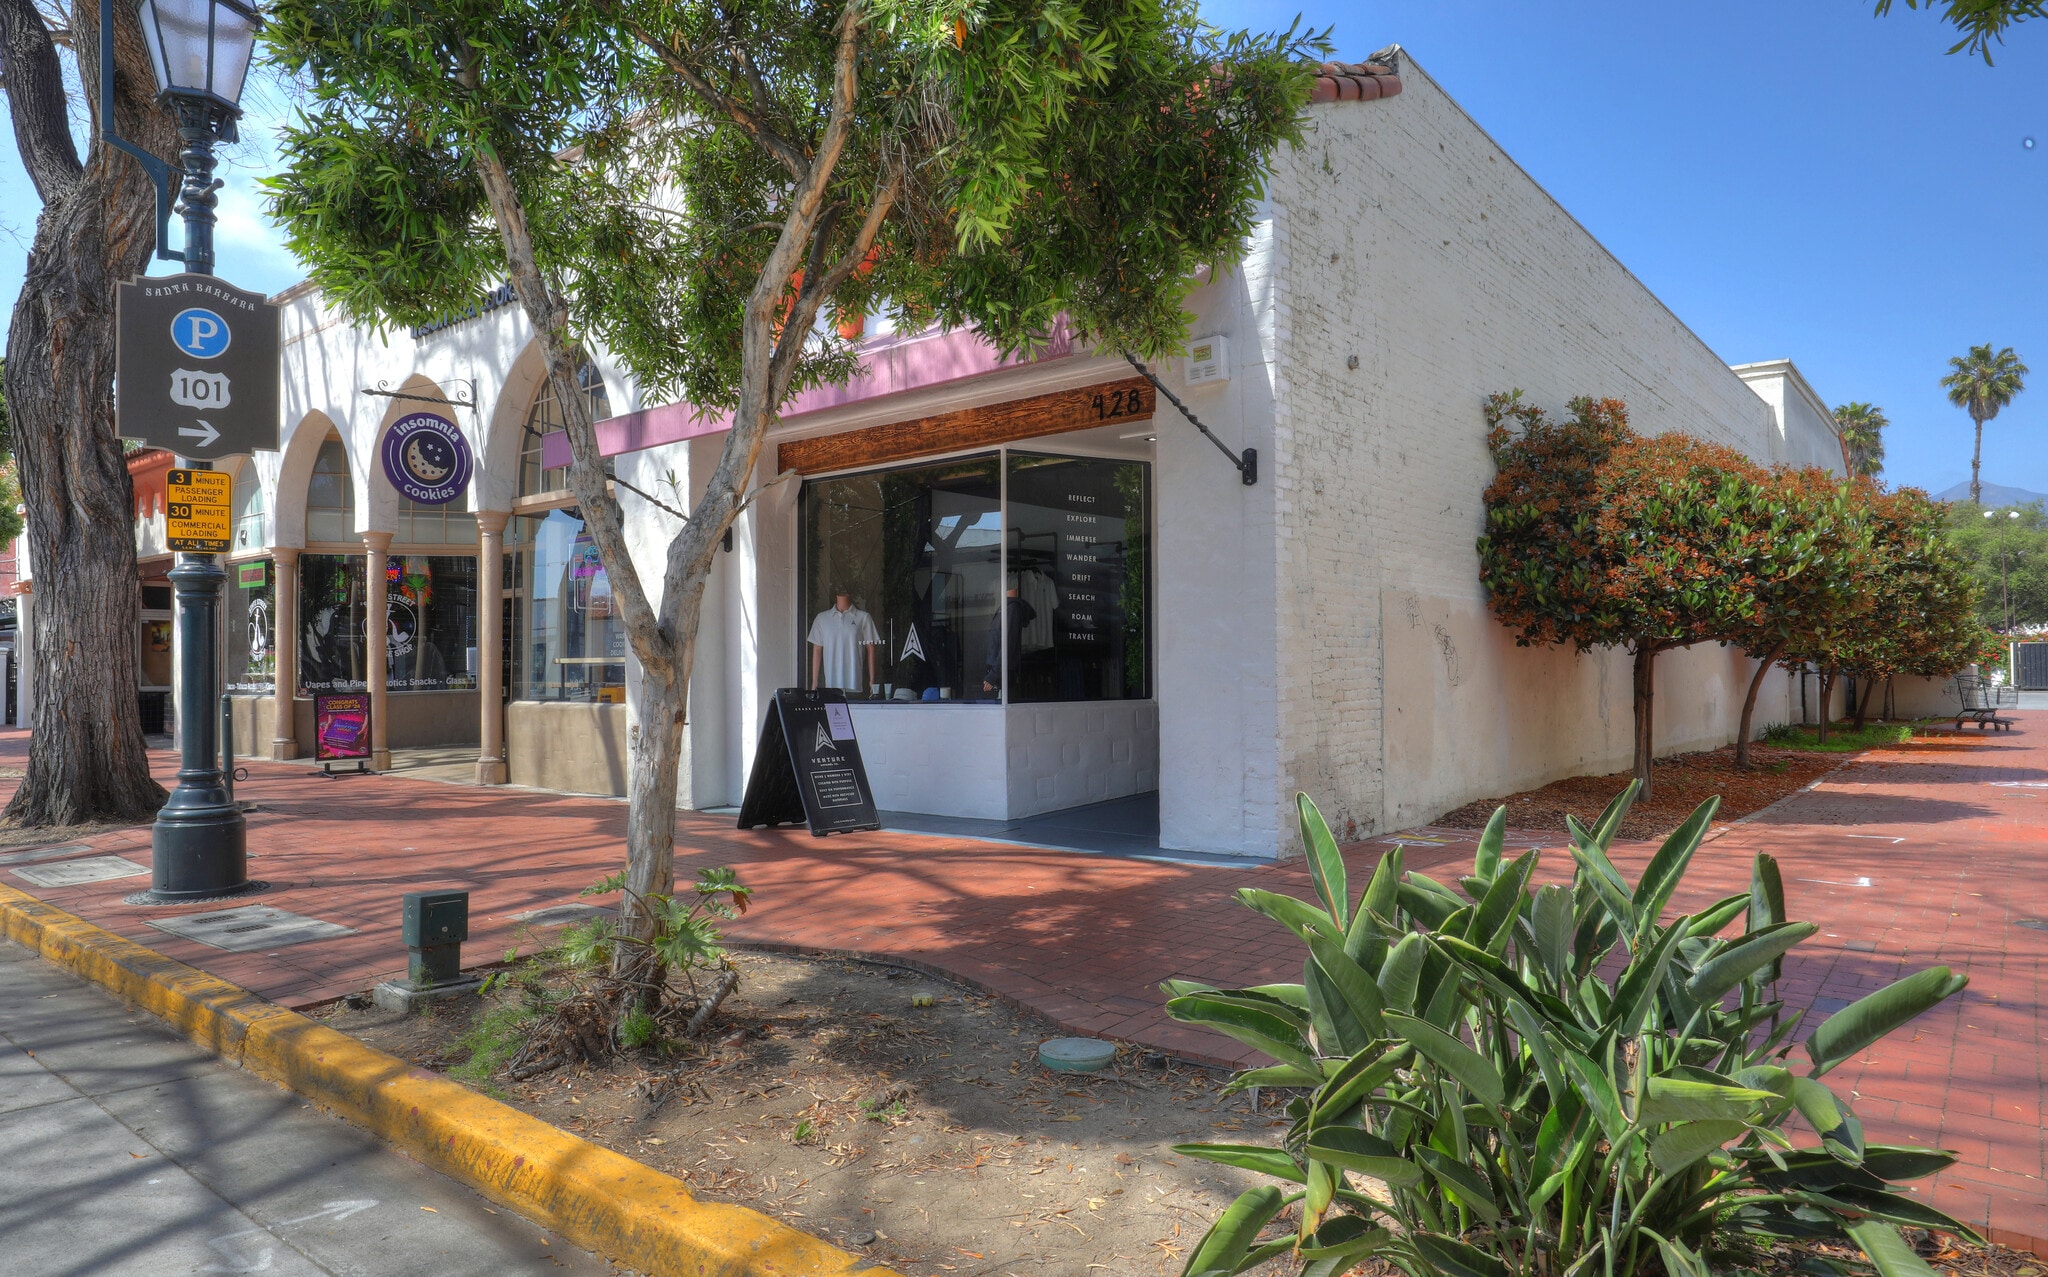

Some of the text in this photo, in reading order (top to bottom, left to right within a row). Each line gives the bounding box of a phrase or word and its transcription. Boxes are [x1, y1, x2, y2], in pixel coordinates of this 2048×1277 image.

[145, 283, 255, 311] SANTA BARBARA
[187, 316, 218, 350] P
[180, 377, 222, 402] 101
[1092, 388, 1140, 420] 428
[393, 418, 460, 443] insomnia
[175, 472, 226, 486] 3 MINUTE
[175, 487, 224, 496] PASSENGER
[404, 484, 455, 500] cookies
[181, 495, 217, 503] LOADING
[1068, 494, 1096, 503] REFLECT
[171, 505, 226, 517] 30 MINUTE
[1066, 515, 1097, 524] EXPLORE
[171, 521, 227, 530] COMMERCIAL
[180, 530, 218, 538] LOADING
[1066, 534, 1097, 543] IMMERSE
[1066, 554, 1097, 563] WANDER
[1071, 573, 1091, 582] DRIFT
[388, 593, 416, 607] STREET
[1068, 593, 1096, 601] SEARCH
[1071, 613, 1092, 621] ROAM
[1068, 632, 1095, 641] TRAVEL
[394, 643, 413, 657] SHOP
[332, 680, 348, 688] and
[350, 680, 368, 690] Pipe
[409, 677, 437, 686] Snacks
[446, 677, 466, 685] Glass
[811, 756, 846, 764] VENTURE
